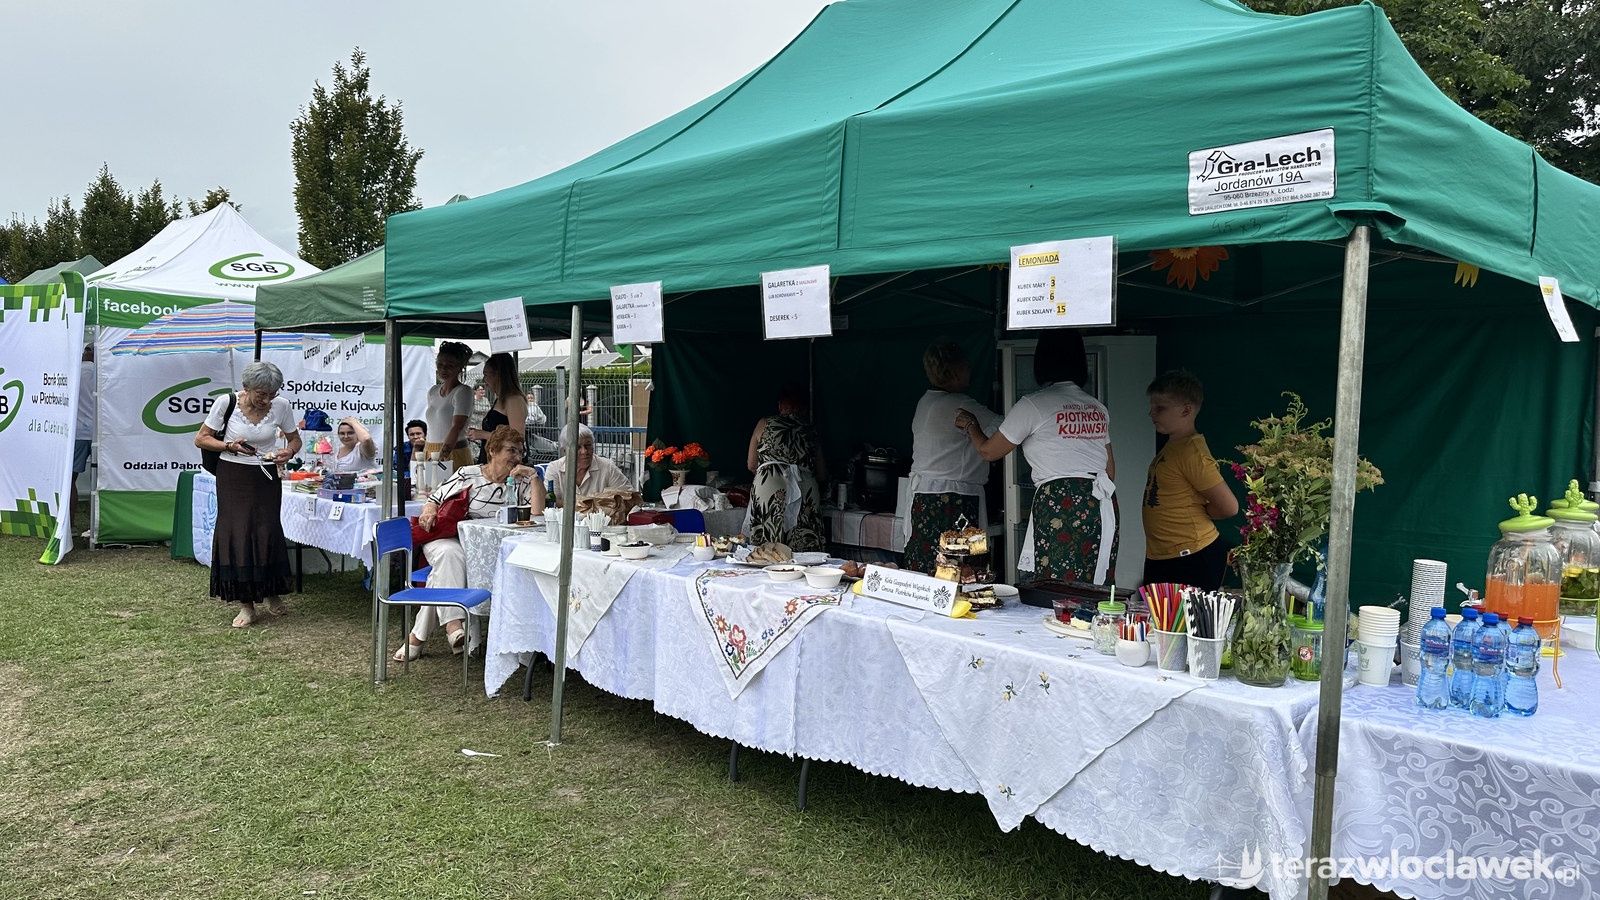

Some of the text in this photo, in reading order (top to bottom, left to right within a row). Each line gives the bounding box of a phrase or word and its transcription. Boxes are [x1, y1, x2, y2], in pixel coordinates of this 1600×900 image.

[1217, 146, 1321, 175] Gra-Lech
[1214, 170, 1304, 192] Jordanów 19A
[1244, 190, 1270, 199] Brzeziny
[1018, 254, 1060, 266] LEMONIADA
[230, 262, 279, 274] SGB
[767, 280, 796, 289] GALARETKA
[1050, 279, 1056, 288] 3
[1049, 292, 1055, 301] 6
[103, 298, 182, 315] facebook
[1056, 305, 1066, 314] 15
[769, 314, 790, 322] DESEREK
[286, 380, 365, 396] Spółdzielczy
[168, 396, 215, 414] SGB
[1056, 408, 1106, 424] PIOTRKÓW
[1058, 422, 1108, 435] KUJAWSKI
[123, 461, 168, 470] Oddział
